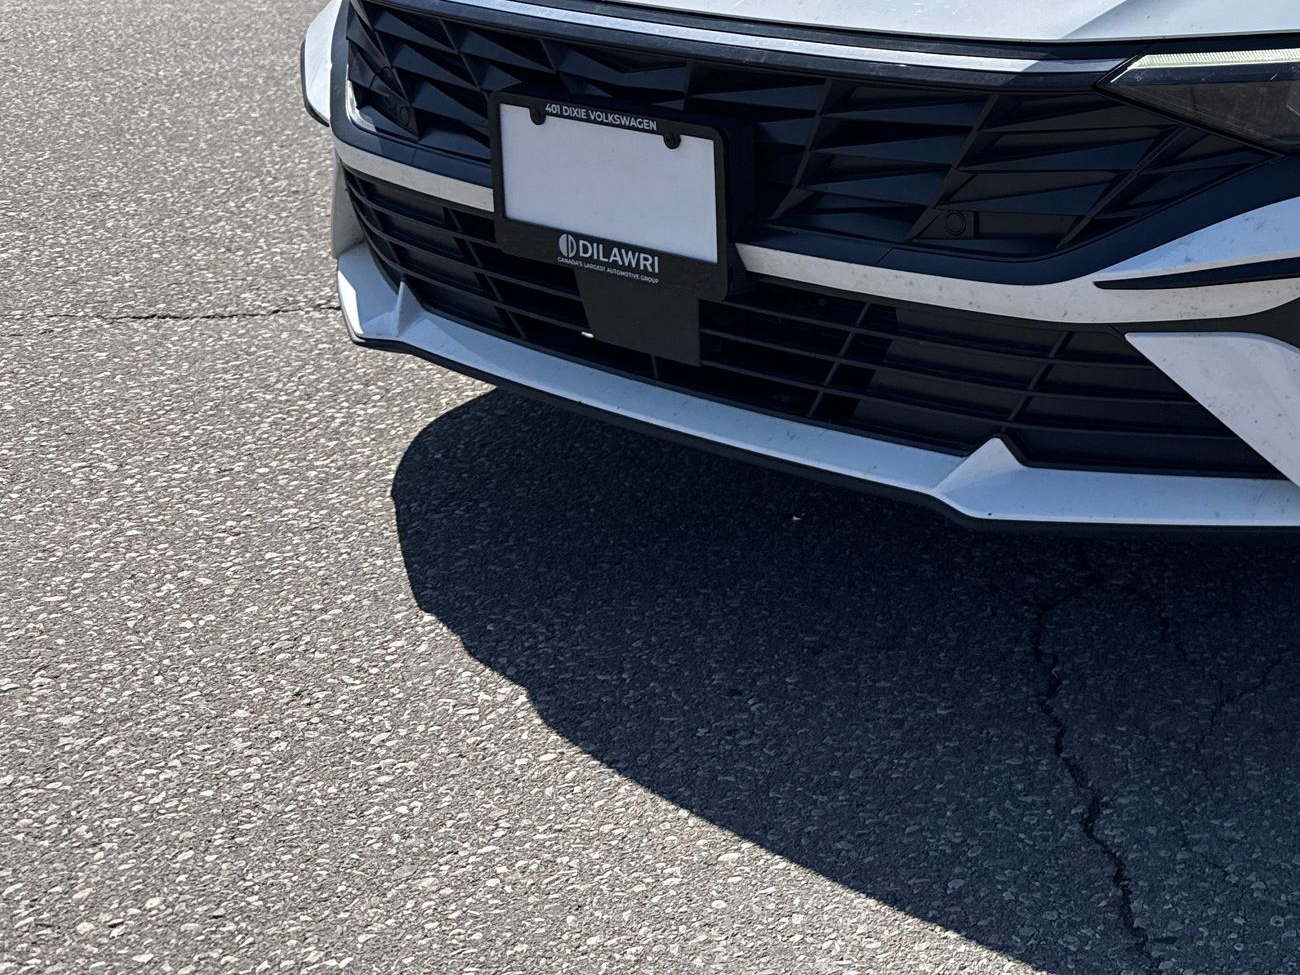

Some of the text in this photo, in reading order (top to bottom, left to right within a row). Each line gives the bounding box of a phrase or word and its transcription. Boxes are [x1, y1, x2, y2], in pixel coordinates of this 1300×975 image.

[545, 103, 657, 131] 401 DIXIE VOLKSWAGEN
[579, 239, 659, 274] DILAWRI
[583, 262, 606, 272] LARGEST
[606, 267, 640, 280] AUTOMOTIVE
[640, 274, 659, 284] GROUP
